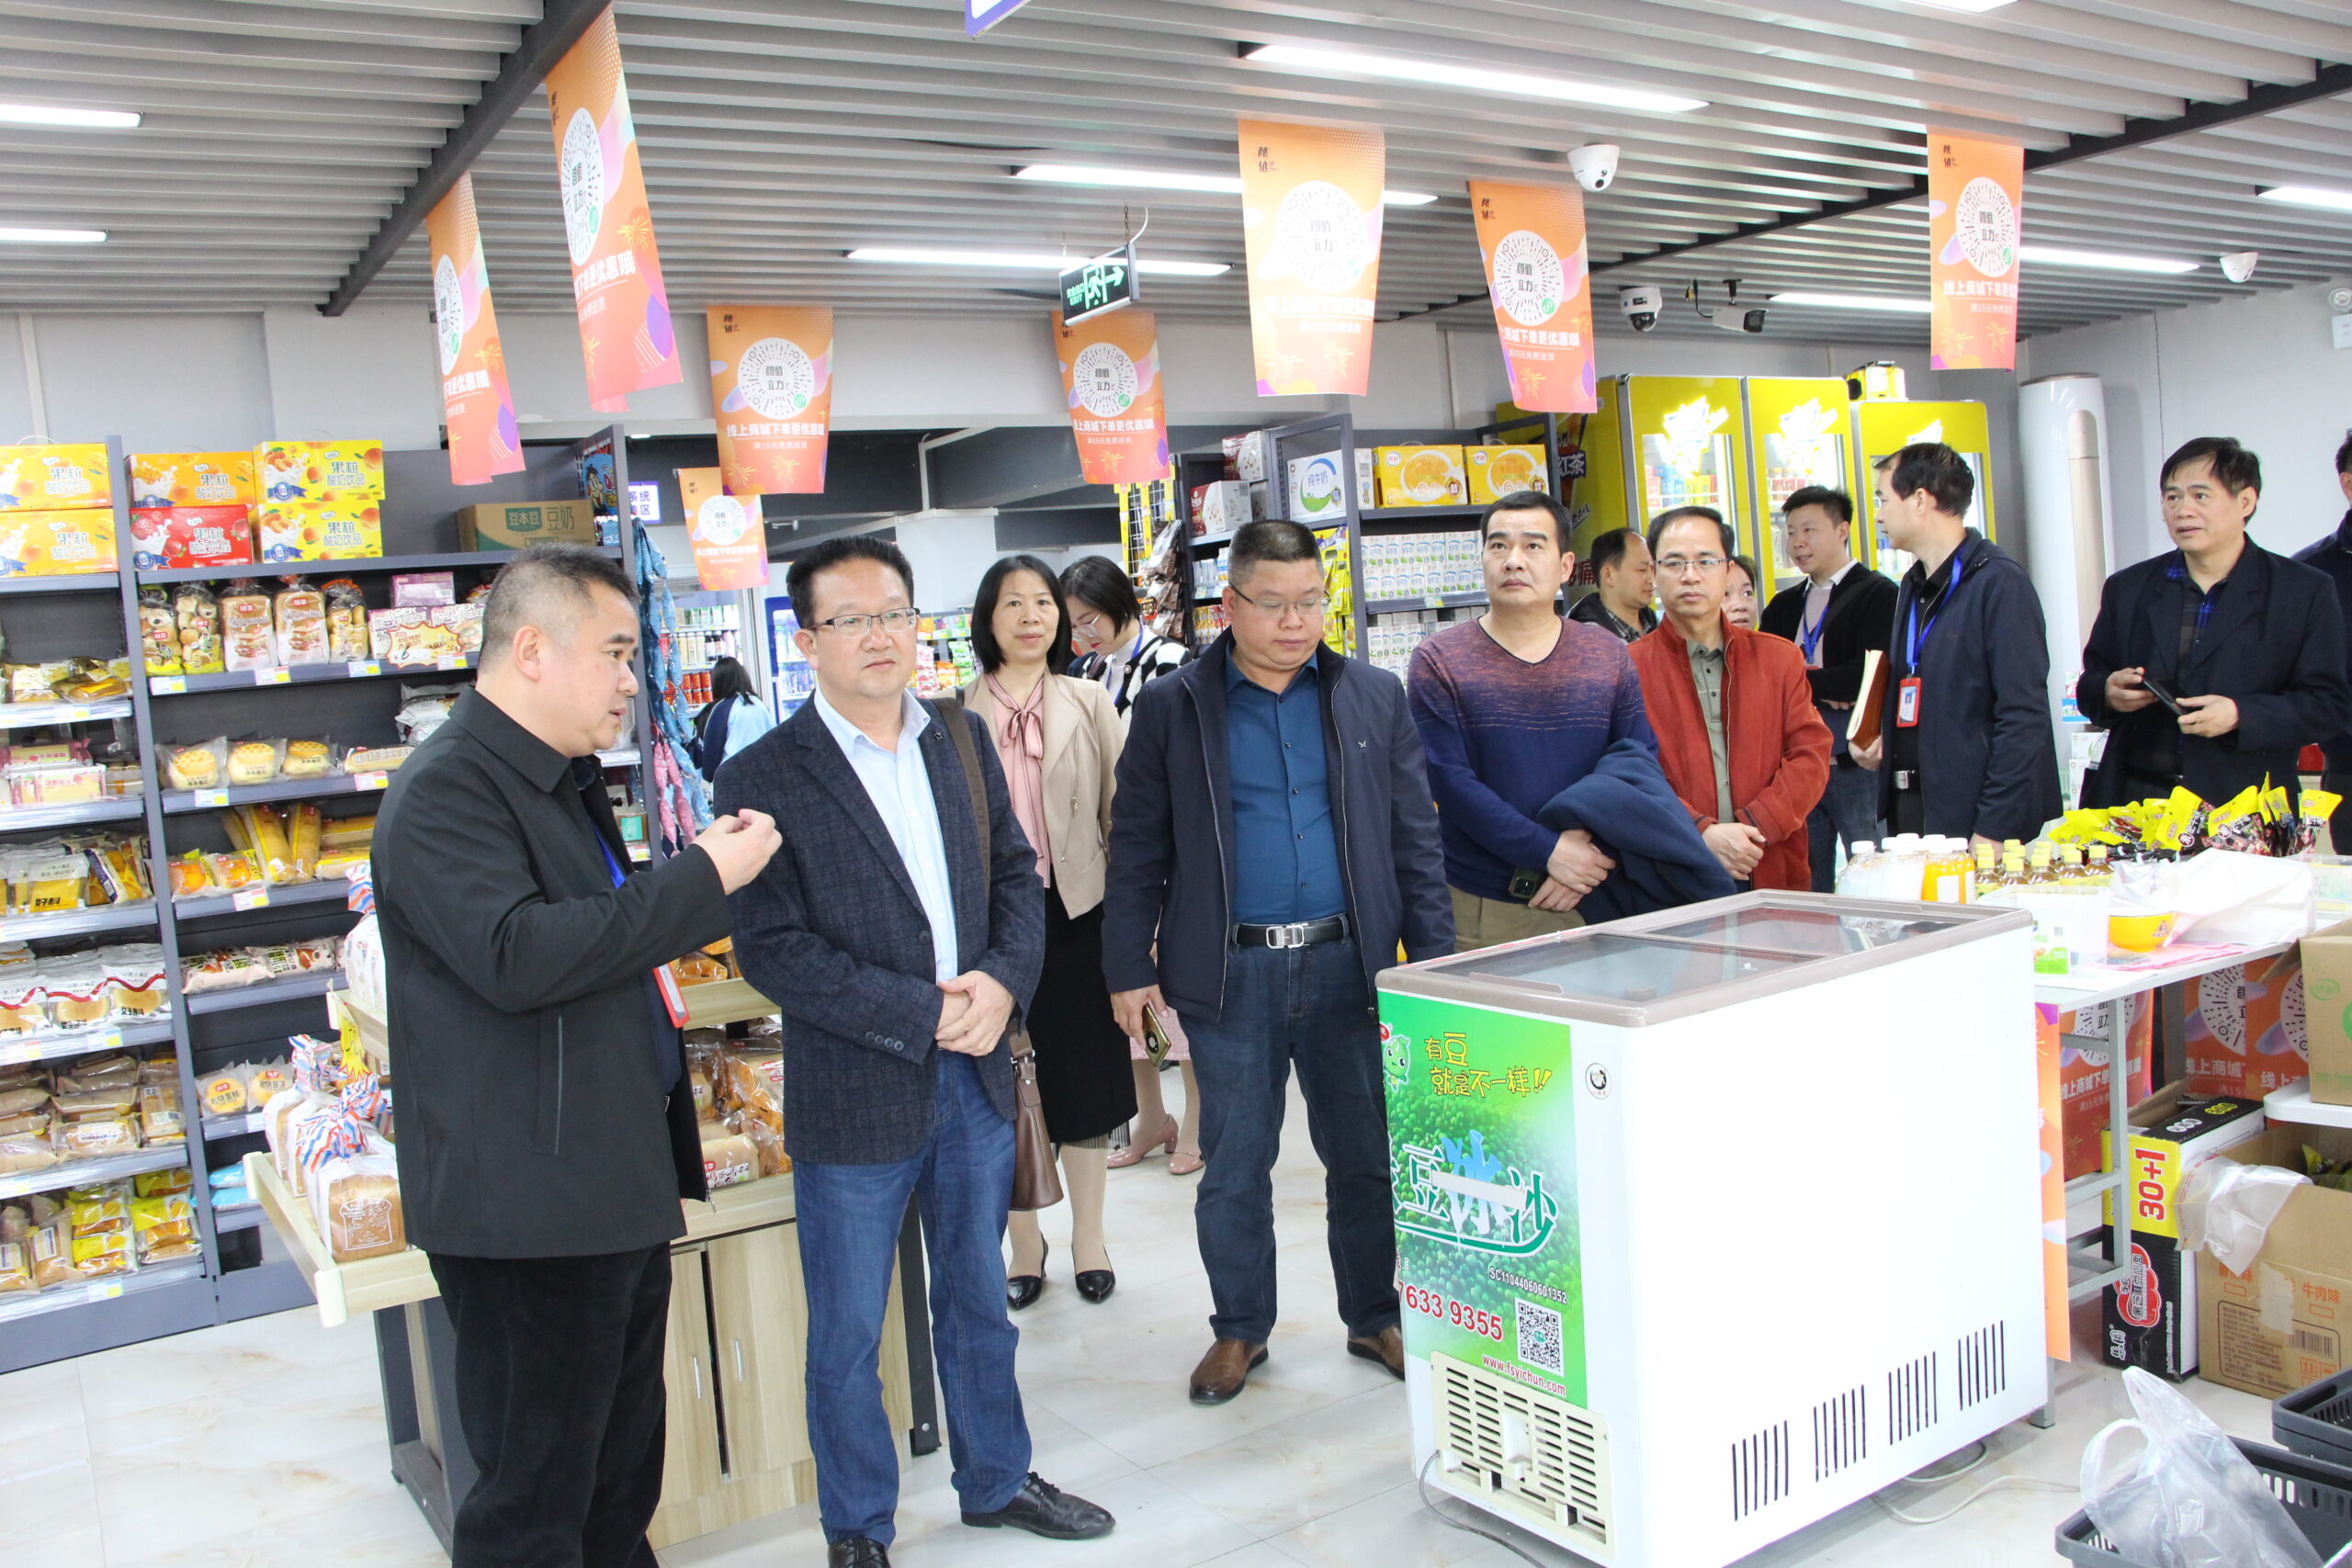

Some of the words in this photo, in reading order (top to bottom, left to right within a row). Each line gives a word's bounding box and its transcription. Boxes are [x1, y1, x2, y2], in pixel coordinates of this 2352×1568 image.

[1069, 293, 1083, 306] EXIT
[51, 466, 83, 480] 果粒
[332, 461, 359, 474] 果粒
[200, 473, 230, 486] 果粒
[1307, 470, 1329, 487] 纯牛奶
[508, 511, 540, 525] 豆本豆
[544, 506, 575, 531] 豆奶
[194, 527, 224, 540] 果粒
[328, 521, 356, 534] 果粒
[57, 532, 89, 545] 果粒
[1425, 1032, 1469, 1067] 有豆
[2135, 1148, 2166, 1221] 30+1
[2301, 1281, 2341, 1305] 牛肉味
[1449, 1300, 1504, 1343] 9355
[1481, 1354, 1567, 1397] www.fsyichun.com
